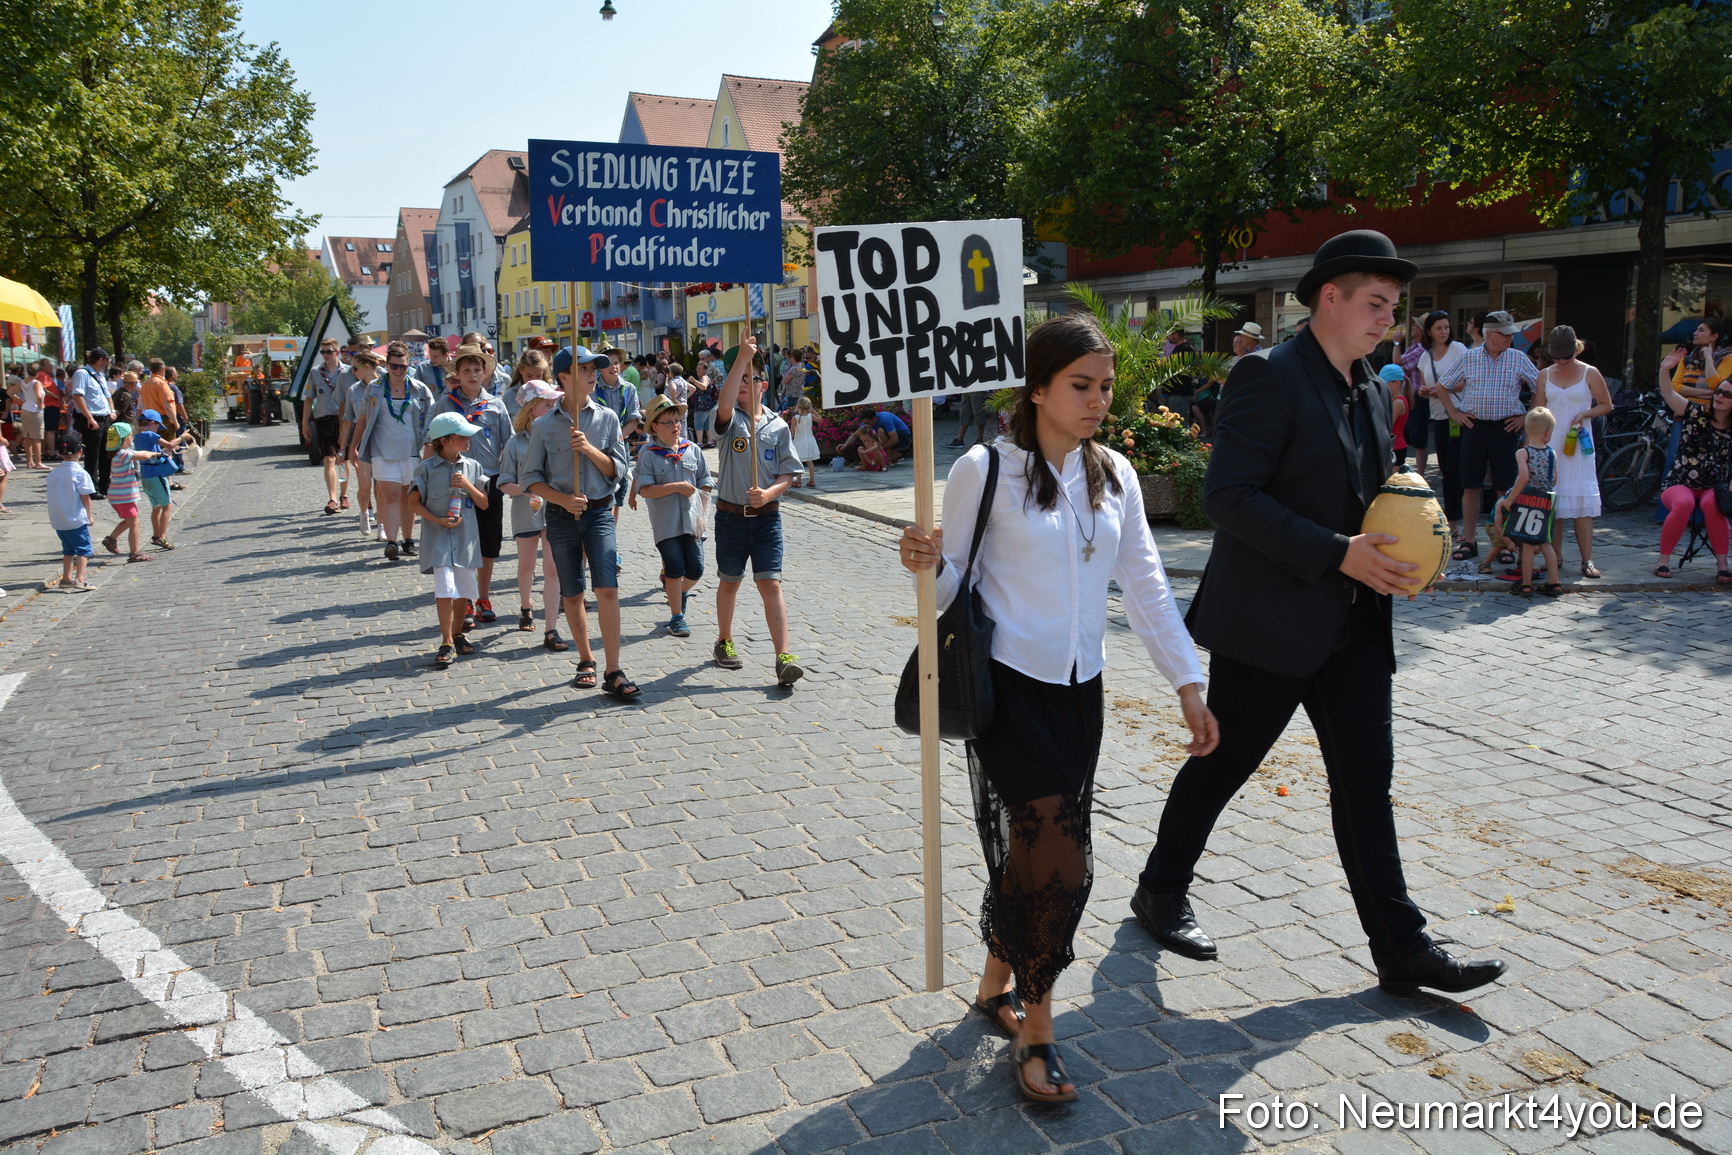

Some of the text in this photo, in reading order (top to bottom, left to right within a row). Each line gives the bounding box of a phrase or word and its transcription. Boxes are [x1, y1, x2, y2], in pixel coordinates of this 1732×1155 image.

[550, 149, 757, 196] SIEDLUNG TAIZÉ
[547, 194, 771, 231] Verband Christlicher
[588, 232, 726, 271] Pfadfinder
[816, 226, 941, 290] TOD
[821, 285, 941, 346] UND
[834, 315, 1025, 406] STERBEN
[1514, 507, 1545, 536] 76
